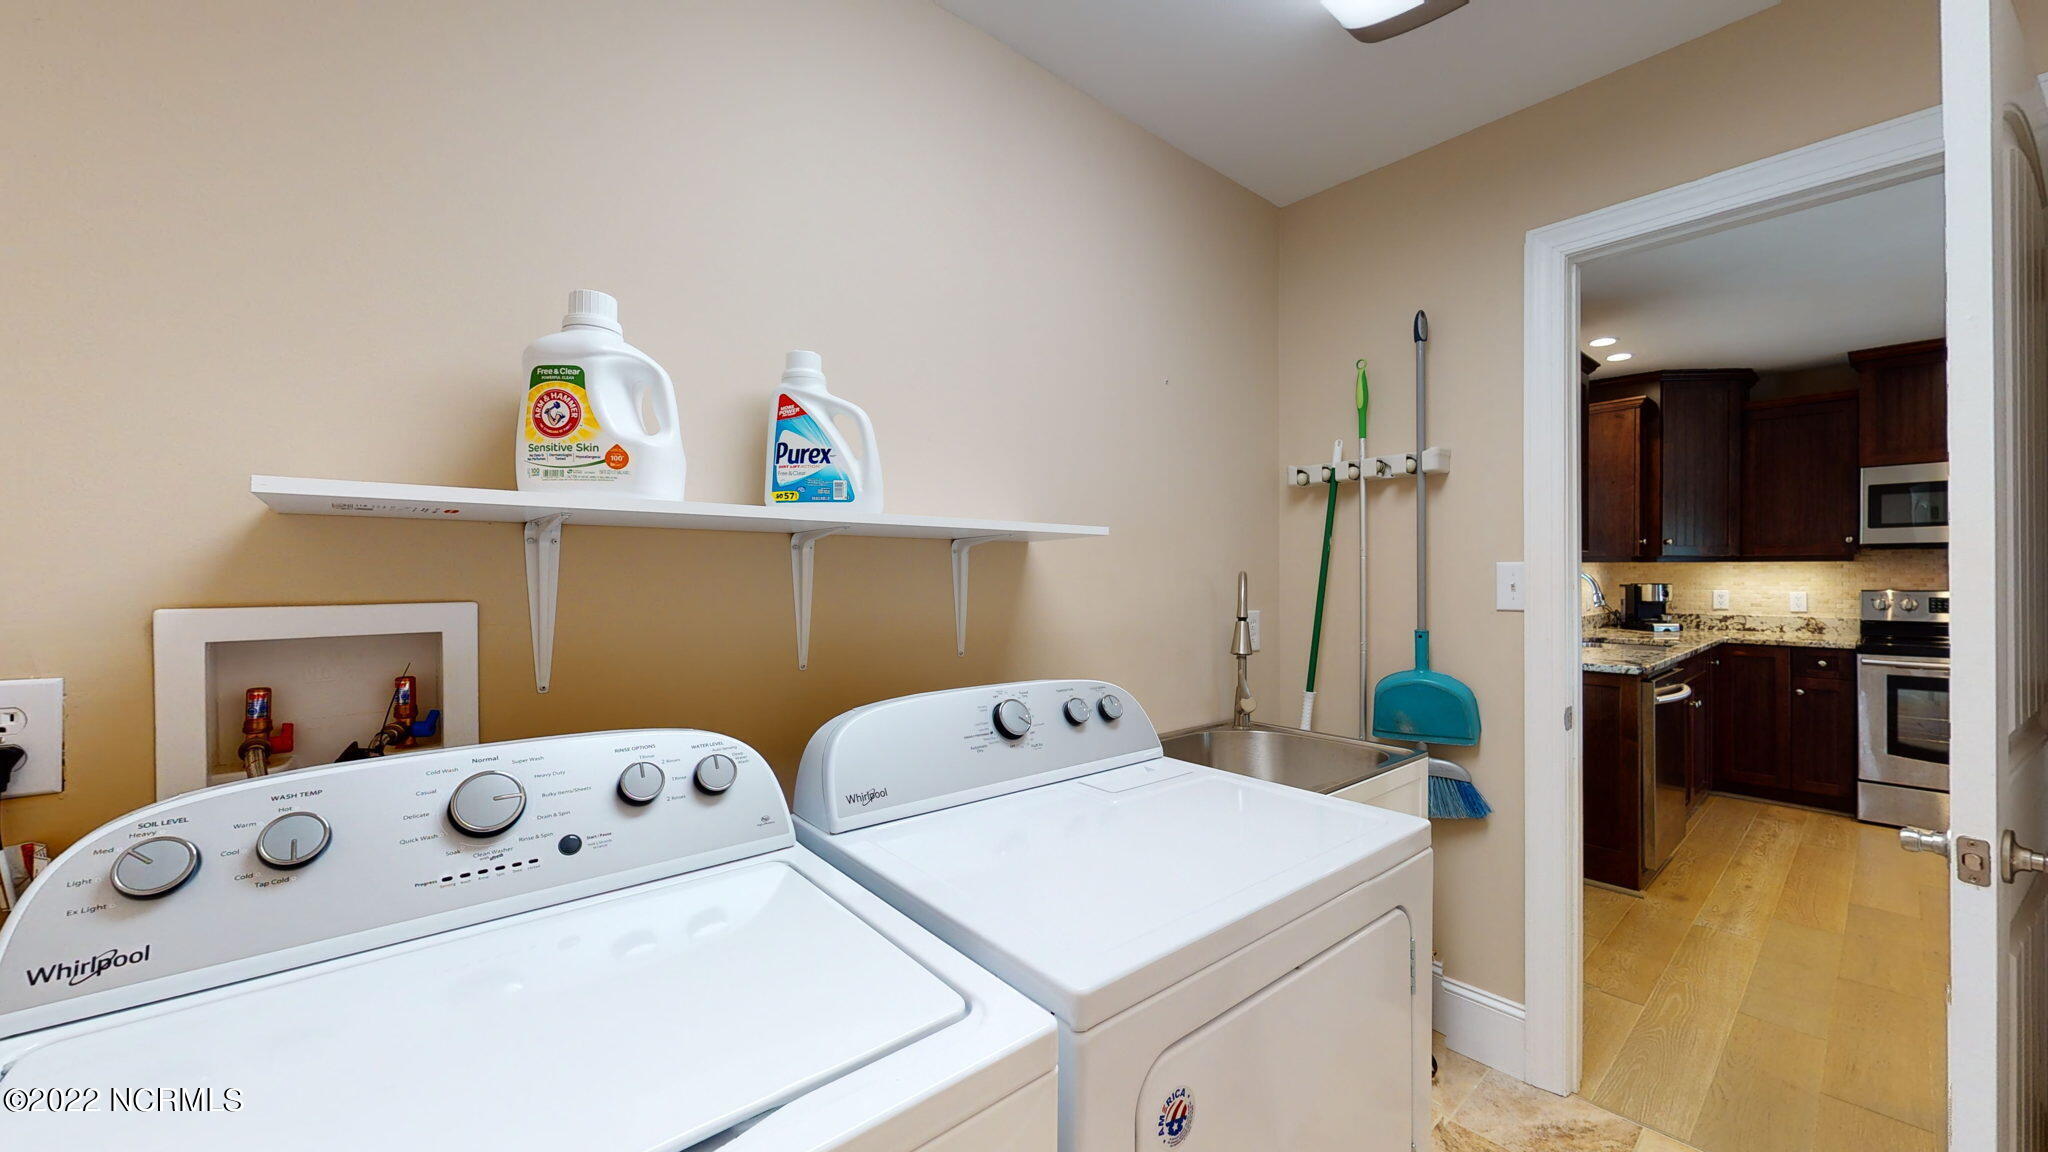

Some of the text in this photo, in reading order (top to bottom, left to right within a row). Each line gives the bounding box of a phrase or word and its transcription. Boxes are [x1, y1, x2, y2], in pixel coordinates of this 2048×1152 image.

[534, 392, 578, 419] ARM & HAMMER
[528, 443, 600, 452] Sensitive Skin
[776, 442, 832, 464] Purex
[472, 756, 500, 764] Normal
[512, 758, 528, 766] Super
[442, 767, 459, 775] Wash
[271, 790, 323, 802] WASH TEMP
[416, 789, 438, 797] Casual
[846, 788, 888, 806] Whirlpool
[403, 812, 430, 821] Delicate
[138, 817, 189, 830] SOIL LEVEL
[233, 822, 257, 830] Warm
[129, 831, 157, 839] Heavy
[400, 834, 439, 846] Quick Wash
[92, 847, 115, 856] Med
[220, 849, 241, 857] Cool
[445, 849, 462, 857] Soak
[473, 847, 514, 859] Clean Washer
[234, 873, 254, 881] Cold
[271, 877, 290, 885] Cold
[66, 879, 92, 888] Light
[81, 904, 107, 914] Light
[26, 945, 151, 987] Whirlpool
